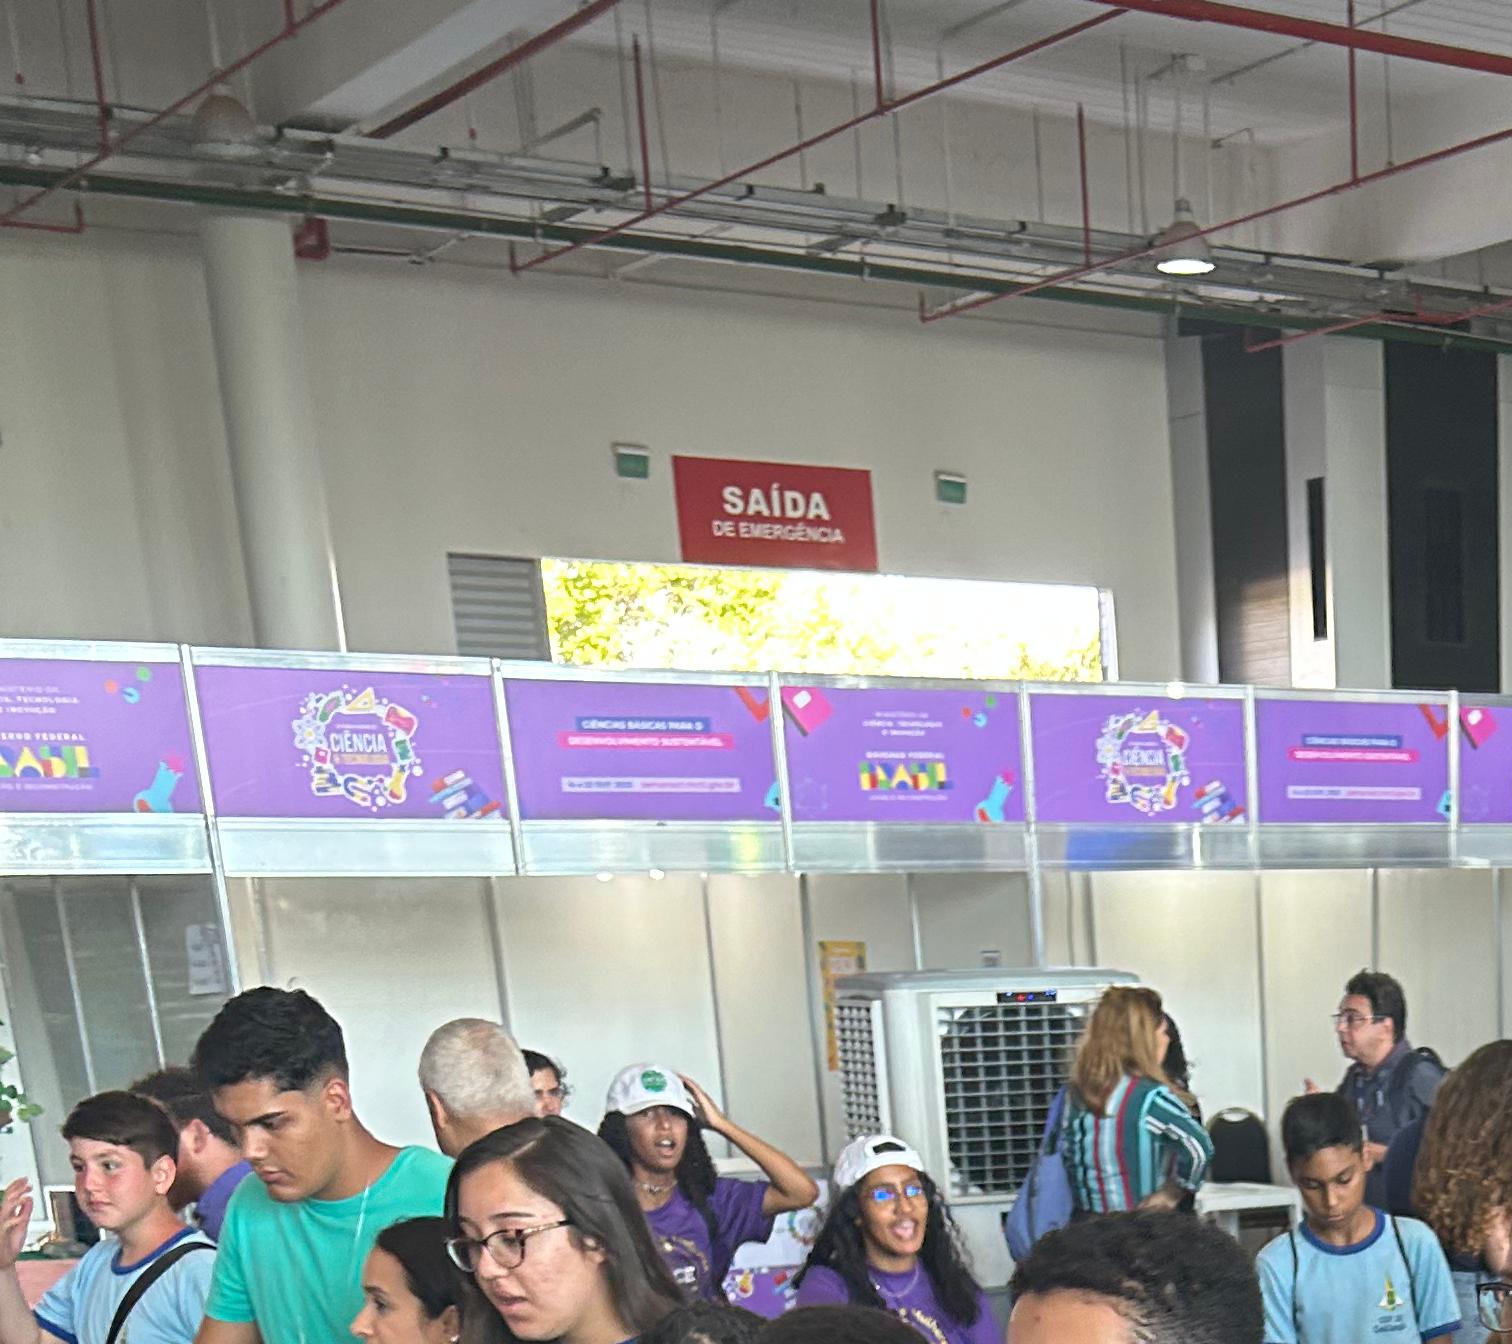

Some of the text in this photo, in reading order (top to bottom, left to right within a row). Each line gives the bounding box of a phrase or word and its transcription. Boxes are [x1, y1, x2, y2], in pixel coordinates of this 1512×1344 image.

[721, 481, 832, 521] SAÍDA
[711, 519, 846, 545] DE EMERGÊNCIA
[328, 729, 389, 753] CIÊNCIA
